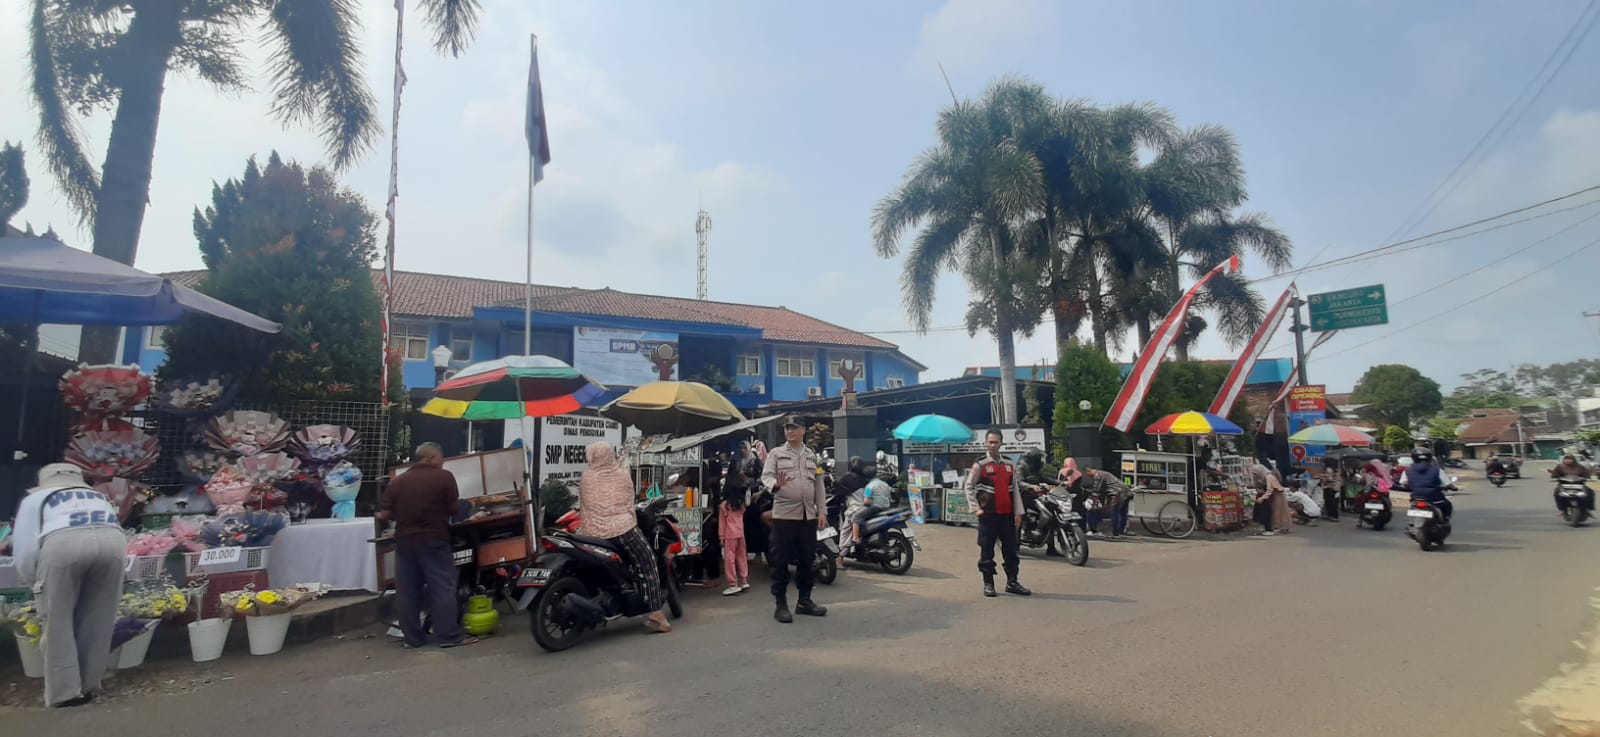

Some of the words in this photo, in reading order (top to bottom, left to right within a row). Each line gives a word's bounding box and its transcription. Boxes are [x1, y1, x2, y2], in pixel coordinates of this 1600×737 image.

[612, 342, 636, 351] SPMB
[563, 427, 578, 436] DINAS
[580, 428, 605, 437] PENDIDIKAN
[545, 444, 562, 464] SMP
[204, 549, 236, 561] 30.000
